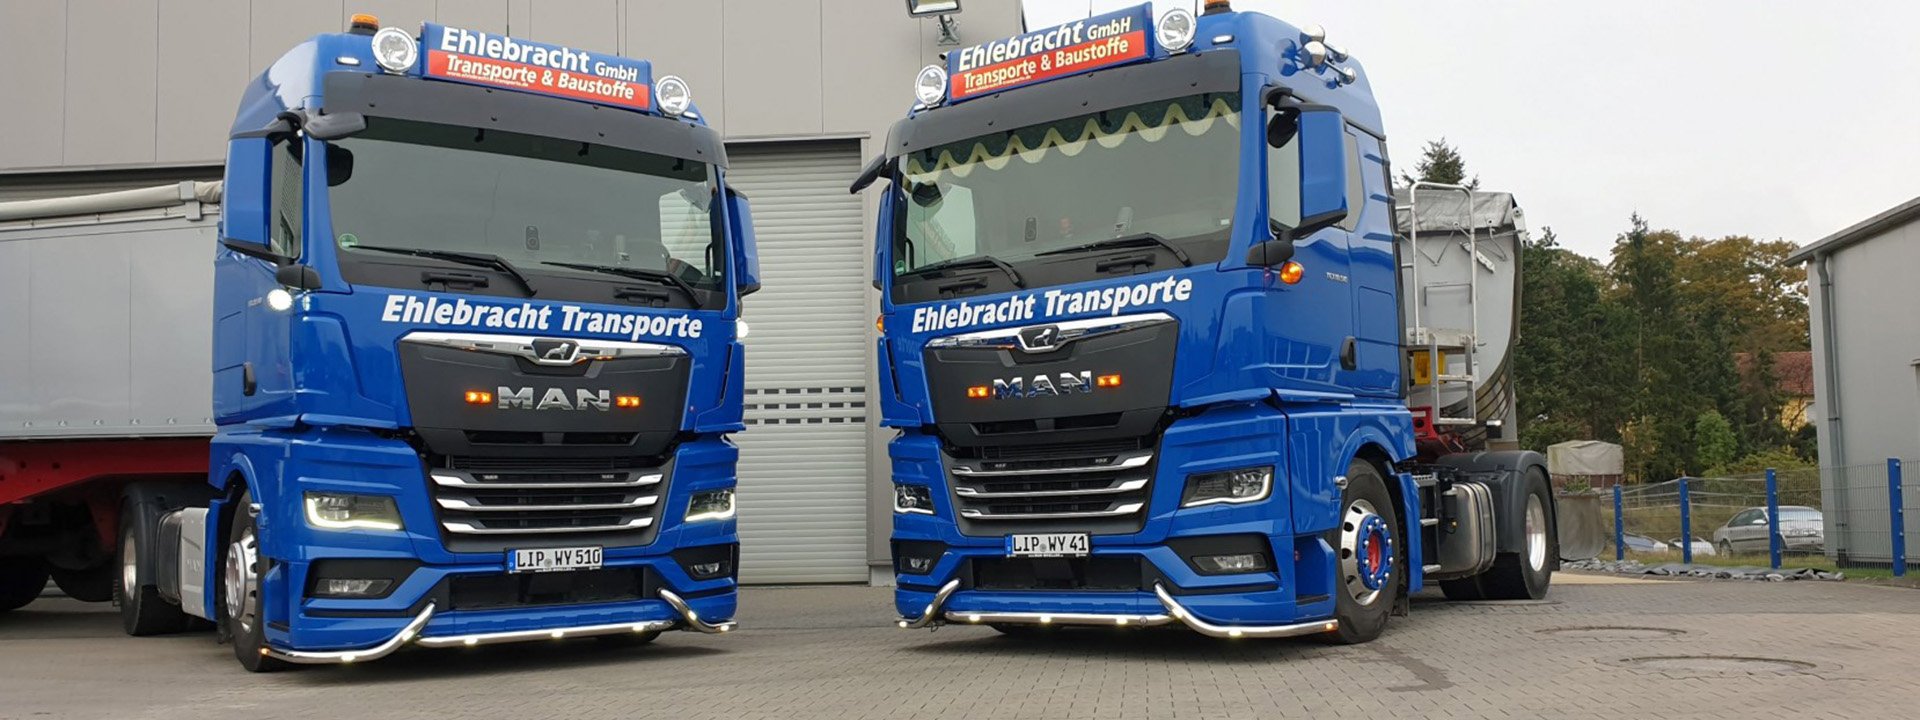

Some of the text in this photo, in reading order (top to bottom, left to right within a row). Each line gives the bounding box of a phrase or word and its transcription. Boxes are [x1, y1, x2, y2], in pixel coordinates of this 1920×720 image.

[441, 26, 638, 82] Ehlebracht GmbH
[958, 16, 1131, 72] Ehlebracht GmbH
[964, 36, 1129, 90] Transporte & Baustoffe
[446, 55, 635, 100] Transporte & Baustoffe
[381, 294, 703, 342] Ehlebracht Transporte
[912, 275, 1193, 333] Ehlebracht Transporte
[497, 386, 610, 412] MAN
[993, 370, 1093, 400] MAN
[516, 551, 545, 568] LIP
[554, 550, 572, 566] WY
[575, 549, 601, 565] 510
[1013, 535, 1087, 552] LIP WY 41
